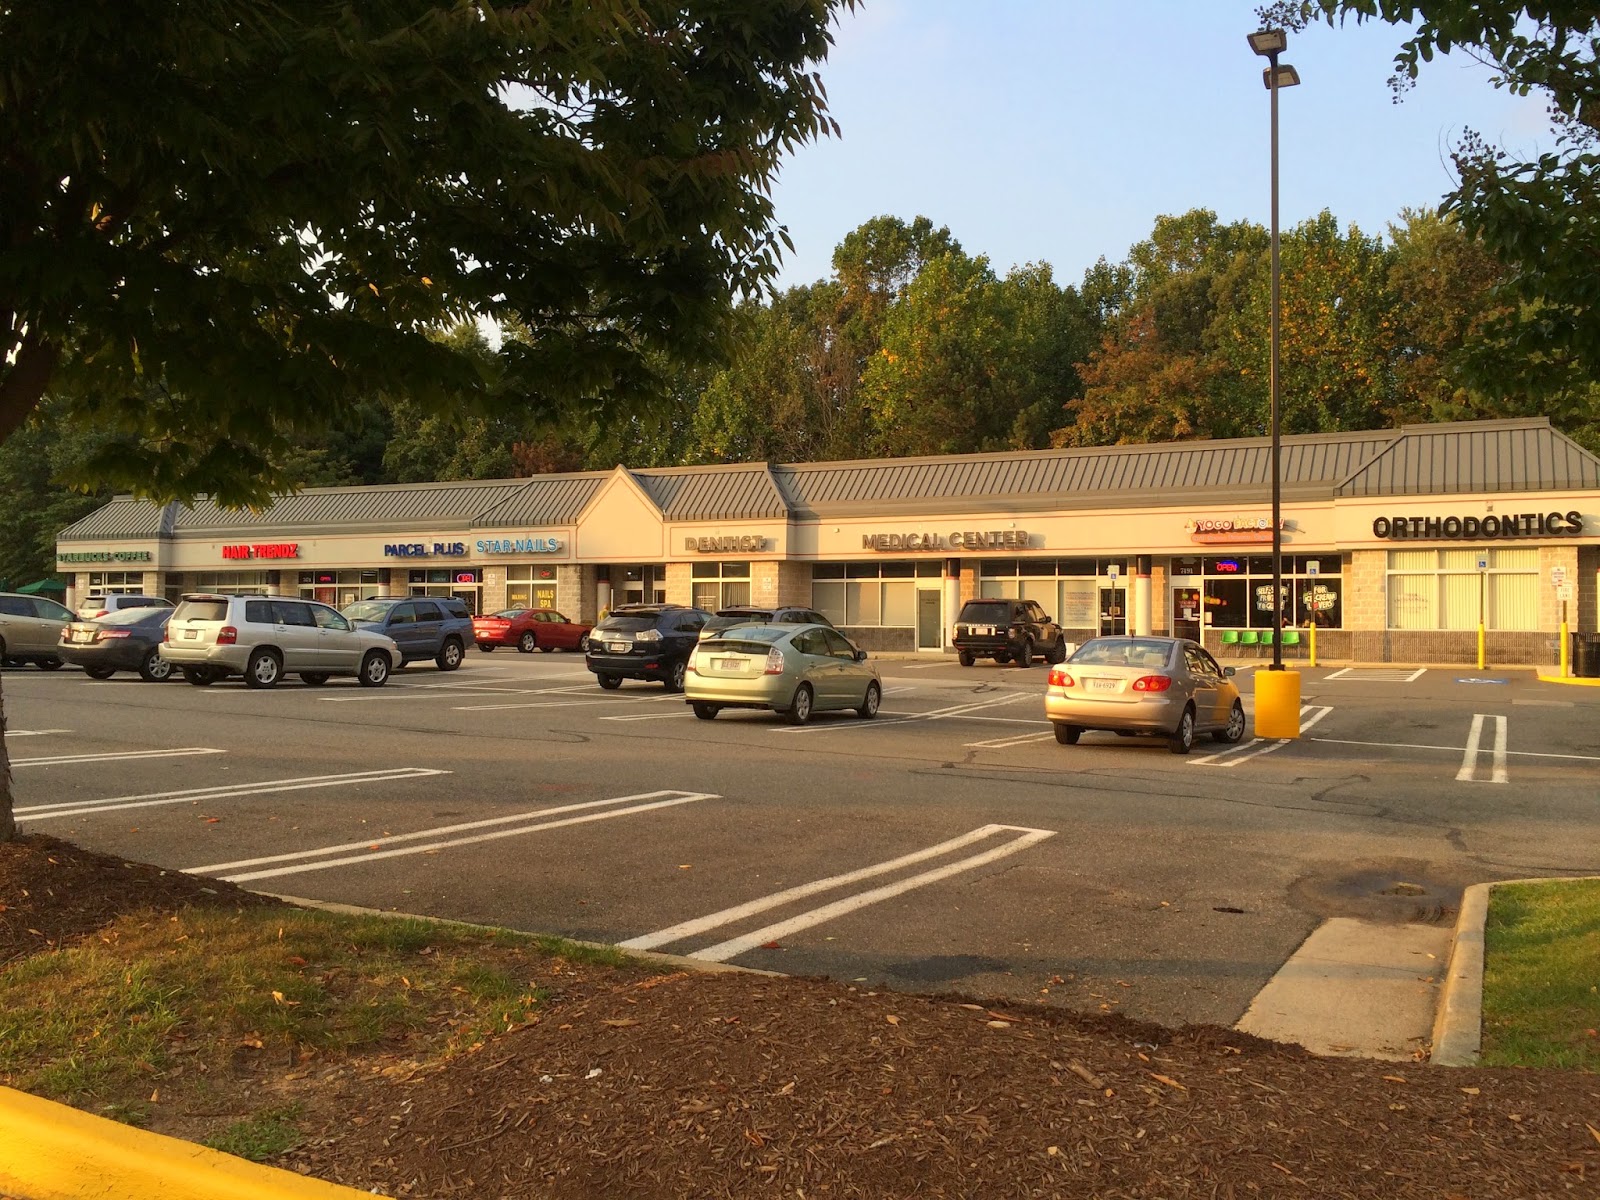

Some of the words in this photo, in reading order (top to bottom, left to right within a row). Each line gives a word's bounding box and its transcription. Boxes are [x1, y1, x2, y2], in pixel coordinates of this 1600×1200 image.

[1196, 519, 1232, 531] YOGO
[1372, 511, 1583, 538] ORTHODONTICS
[477, 540, 513, 553] STAR
[515, 538, 557, 553] NAILS
[685, 535, 764, 552] DENTIST
[862, 533, 943, 550] MEDICAL
[949, 530, 1029, 549] CENTER
[222, 545, 250, 559] HAIR
[252, 544, 298, 558] TRENDZ
[384, 544, 429, 556] PARCEL
[433, 542, 465, 555] PLUS
[57, 553, 110, 562] STARBUCKS
[113, 552, 150, 561] COFFEE
[537, 590, 554, 598] NAILS
[1314, 586, 1327, 594] FOR
[540, 599, 552, 608] SPA
